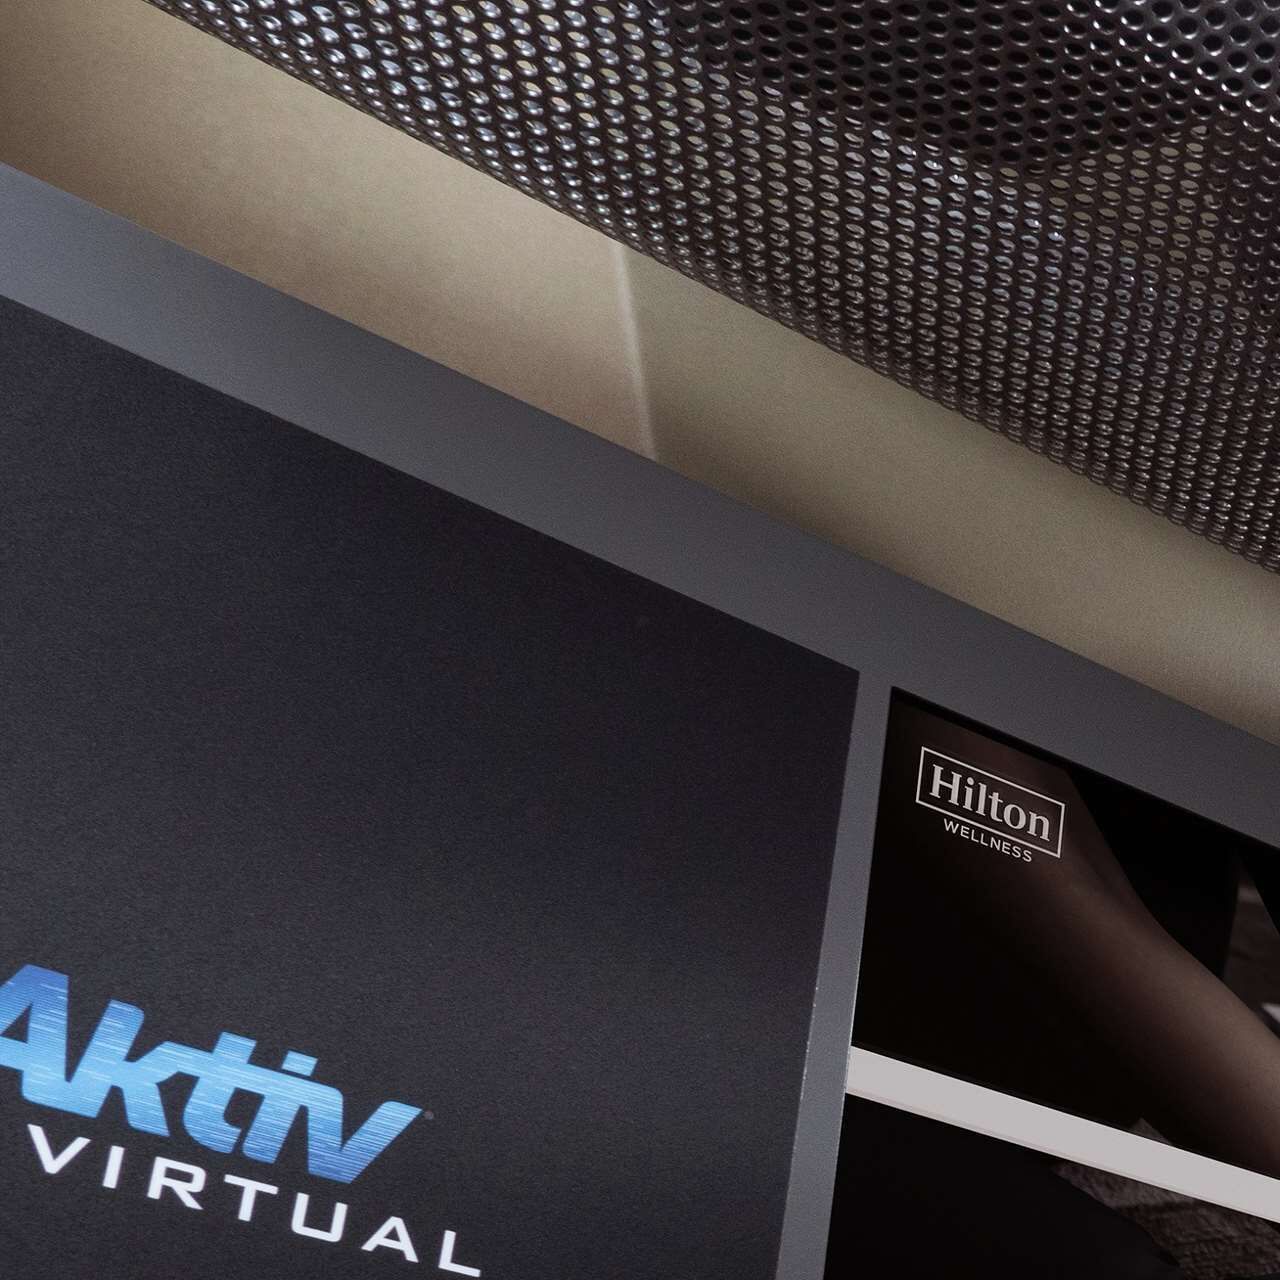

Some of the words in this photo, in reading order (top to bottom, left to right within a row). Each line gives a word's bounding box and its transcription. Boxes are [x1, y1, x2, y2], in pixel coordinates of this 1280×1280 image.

[929, 764, 1050, 841] Hilton
[943, 818, 1033, 863] WELLNESS
[0, 964, 423, 1184] Aktiv
[27, 1123, 482, 1278] VIRTUAL
